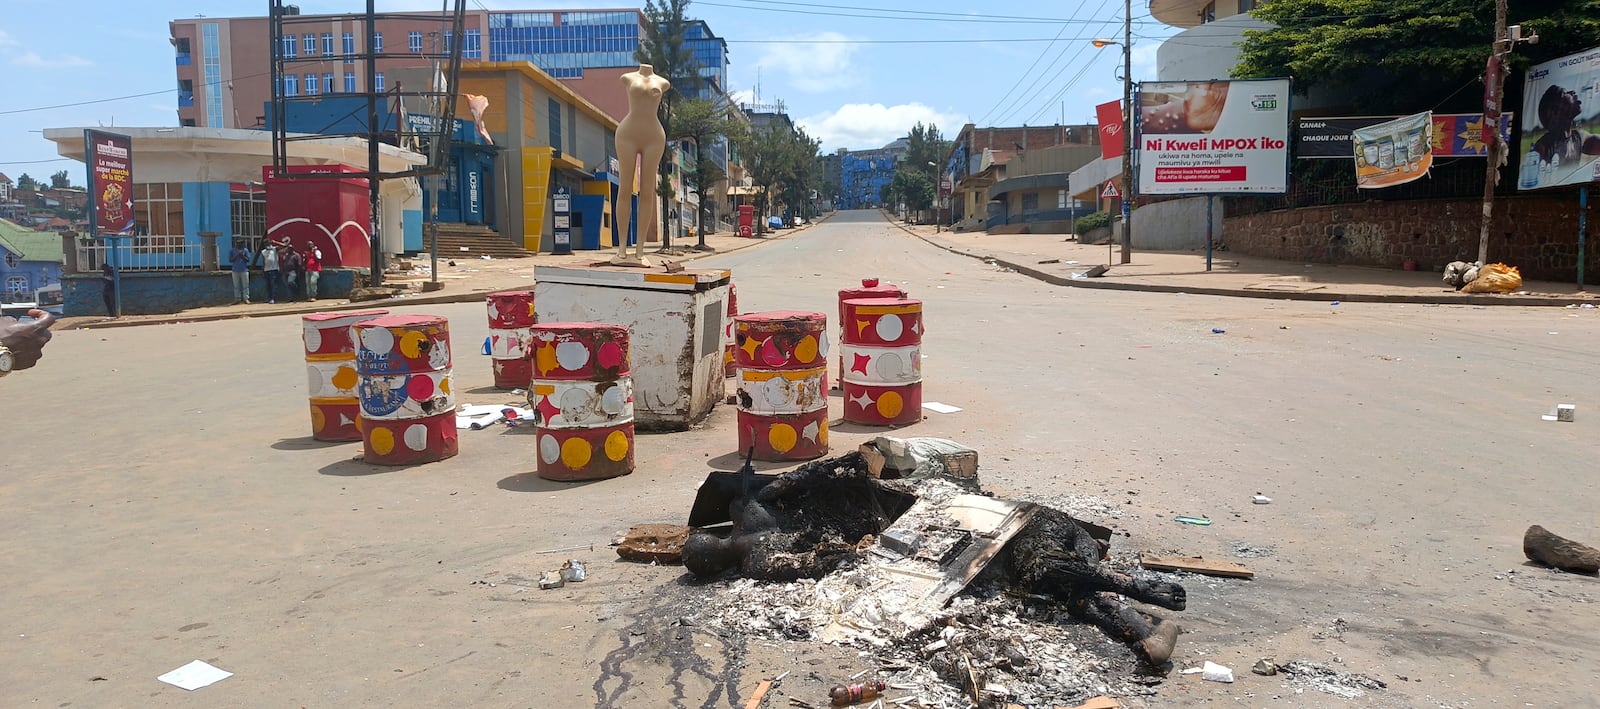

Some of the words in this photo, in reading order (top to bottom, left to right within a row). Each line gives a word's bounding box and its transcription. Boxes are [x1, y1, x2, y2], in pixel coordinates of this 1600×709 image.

[1559, 60, 1567, 68] UN
[1146, 138, 1162, 151] Ni
[1166, 138, 1208, 151] Kweli
[1211, 138, 1258, 150] MPOX
[1261, 137, 1285, 150] iko
[106, 161, 126, 169] meilleur
[109, 173, 114, 181] la
